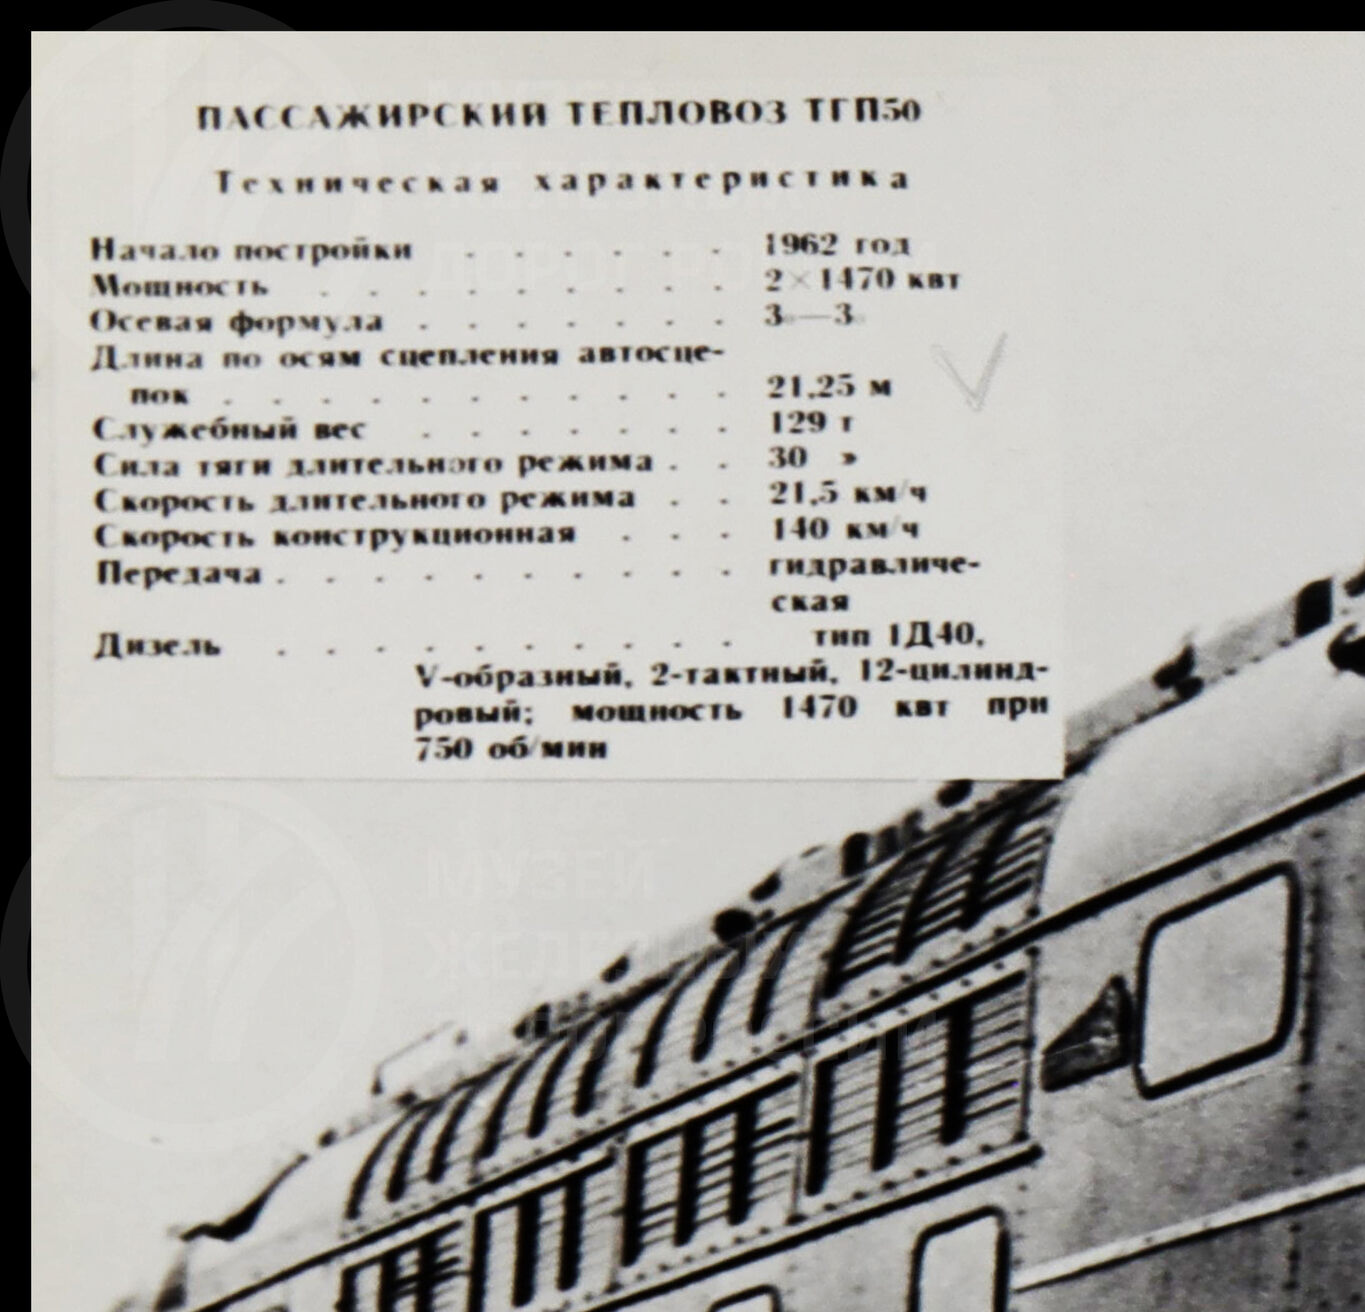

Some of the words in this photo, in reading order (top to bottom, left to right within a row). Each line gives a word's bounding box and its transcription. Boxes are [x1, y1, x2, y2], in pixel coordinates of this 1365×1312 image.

[198, 103, 546, 130] ПАССАЖИРСКИЙ
[568, 99, 787, 126] ТЕПЛОВОЗ
[805, 97, 921, 122] ТГП50
[216, 170, 499, 194] Техническая
[536, 170, 907, 197] характеристика
[91, 237, 219, 261] Начало
[235, 237, 411, 267] постройки
[767, 233, 838, 256] 1962
[856, 238, 909, 255] год
[93, 273, 268, 298] Мощность
[908, 273, 959, 290] квт
[90, 310, 212, 332] Осевая
[229, 310, 383, 338] формула
[91, 345, 203, 371] Длина
[223, 352, 261, 368] по
[280, 351, 361, 368] осям
[380, 349, 559, 368] сцепления
[579, 345, 724, 364] автосце-
[131, 388, 188, 405] пок
[768, 373, 855, 399] 21,25
[870, 379, 891, 396] м
[92, 416, 297, 446] Служебный
[314, 423, 365, 440] вес
[773, 411, 827, 434] 129
[842, 416, 852, 432] т
[94, 453, 179, 477] Сила
[199, 459, 272, 477] тяги
[518, 454, 652, 478] режима
[769, 446, 808, 468] 30
[94, 488, 255, 518] Скорость
[271, 493, 486, 513] длительного
[501, 490, 635, 515] режима
[770, 480, 838, 506] 21,5
[854, 479, 927, 503] км/ч
[94, 524, 255, 553] Скорость
[274, 526, 576, 552] конструкционная
[775, 516, 829, 541] 140
[846, 516, 919, 540] км/ч
[98, 559, 261, 590] Передача
[770, 557, 980, 582] гидравличе-
[771, 594, 849, 613] ская
[94, 632, 221, 660] Дизель
[814, 629, 870, 647] тип
[890, 621, 984, 649] 1Д40,
[416, 662, 633, 694] V-образный,
[651, 658, 838, 686] 2-тактный,
[861, 658, 1048, 682] 12-цилинд-
[415, 699, 533, 732] ровый;
[572, 703, 743, 723] мощность
[784, 694, 858, 719] 1470
[896, 699, 949, 717] квт
[988, 696, 1049, 721] при
[416, 736, 474, 762] 750
[488, 735, 607, 761] об/мин
